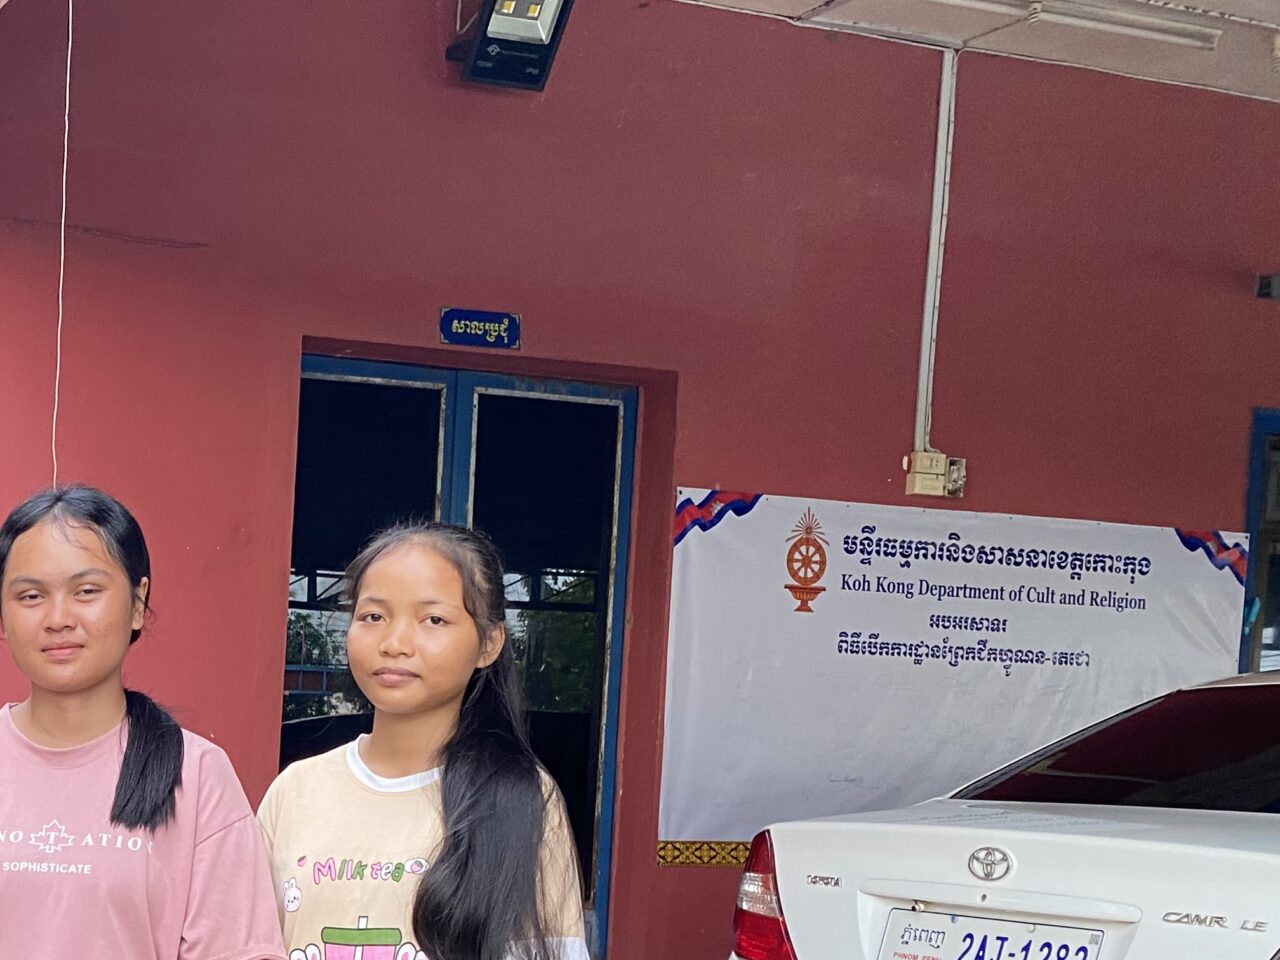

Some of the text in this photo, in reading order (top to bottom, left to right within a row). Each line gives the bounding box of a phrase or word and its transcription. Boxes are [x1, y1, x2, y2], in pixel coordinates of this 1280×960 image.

[841, 574, 1146, 612] Koh Kong Department of Cult and Religion
[2, 861, 92, 875] SOPHISTICATE
[371, 862, 404, 882] tea
[1239, 919, 1269, 932] LE
[900, 923, 946, 949] ភ្នំពេញ
